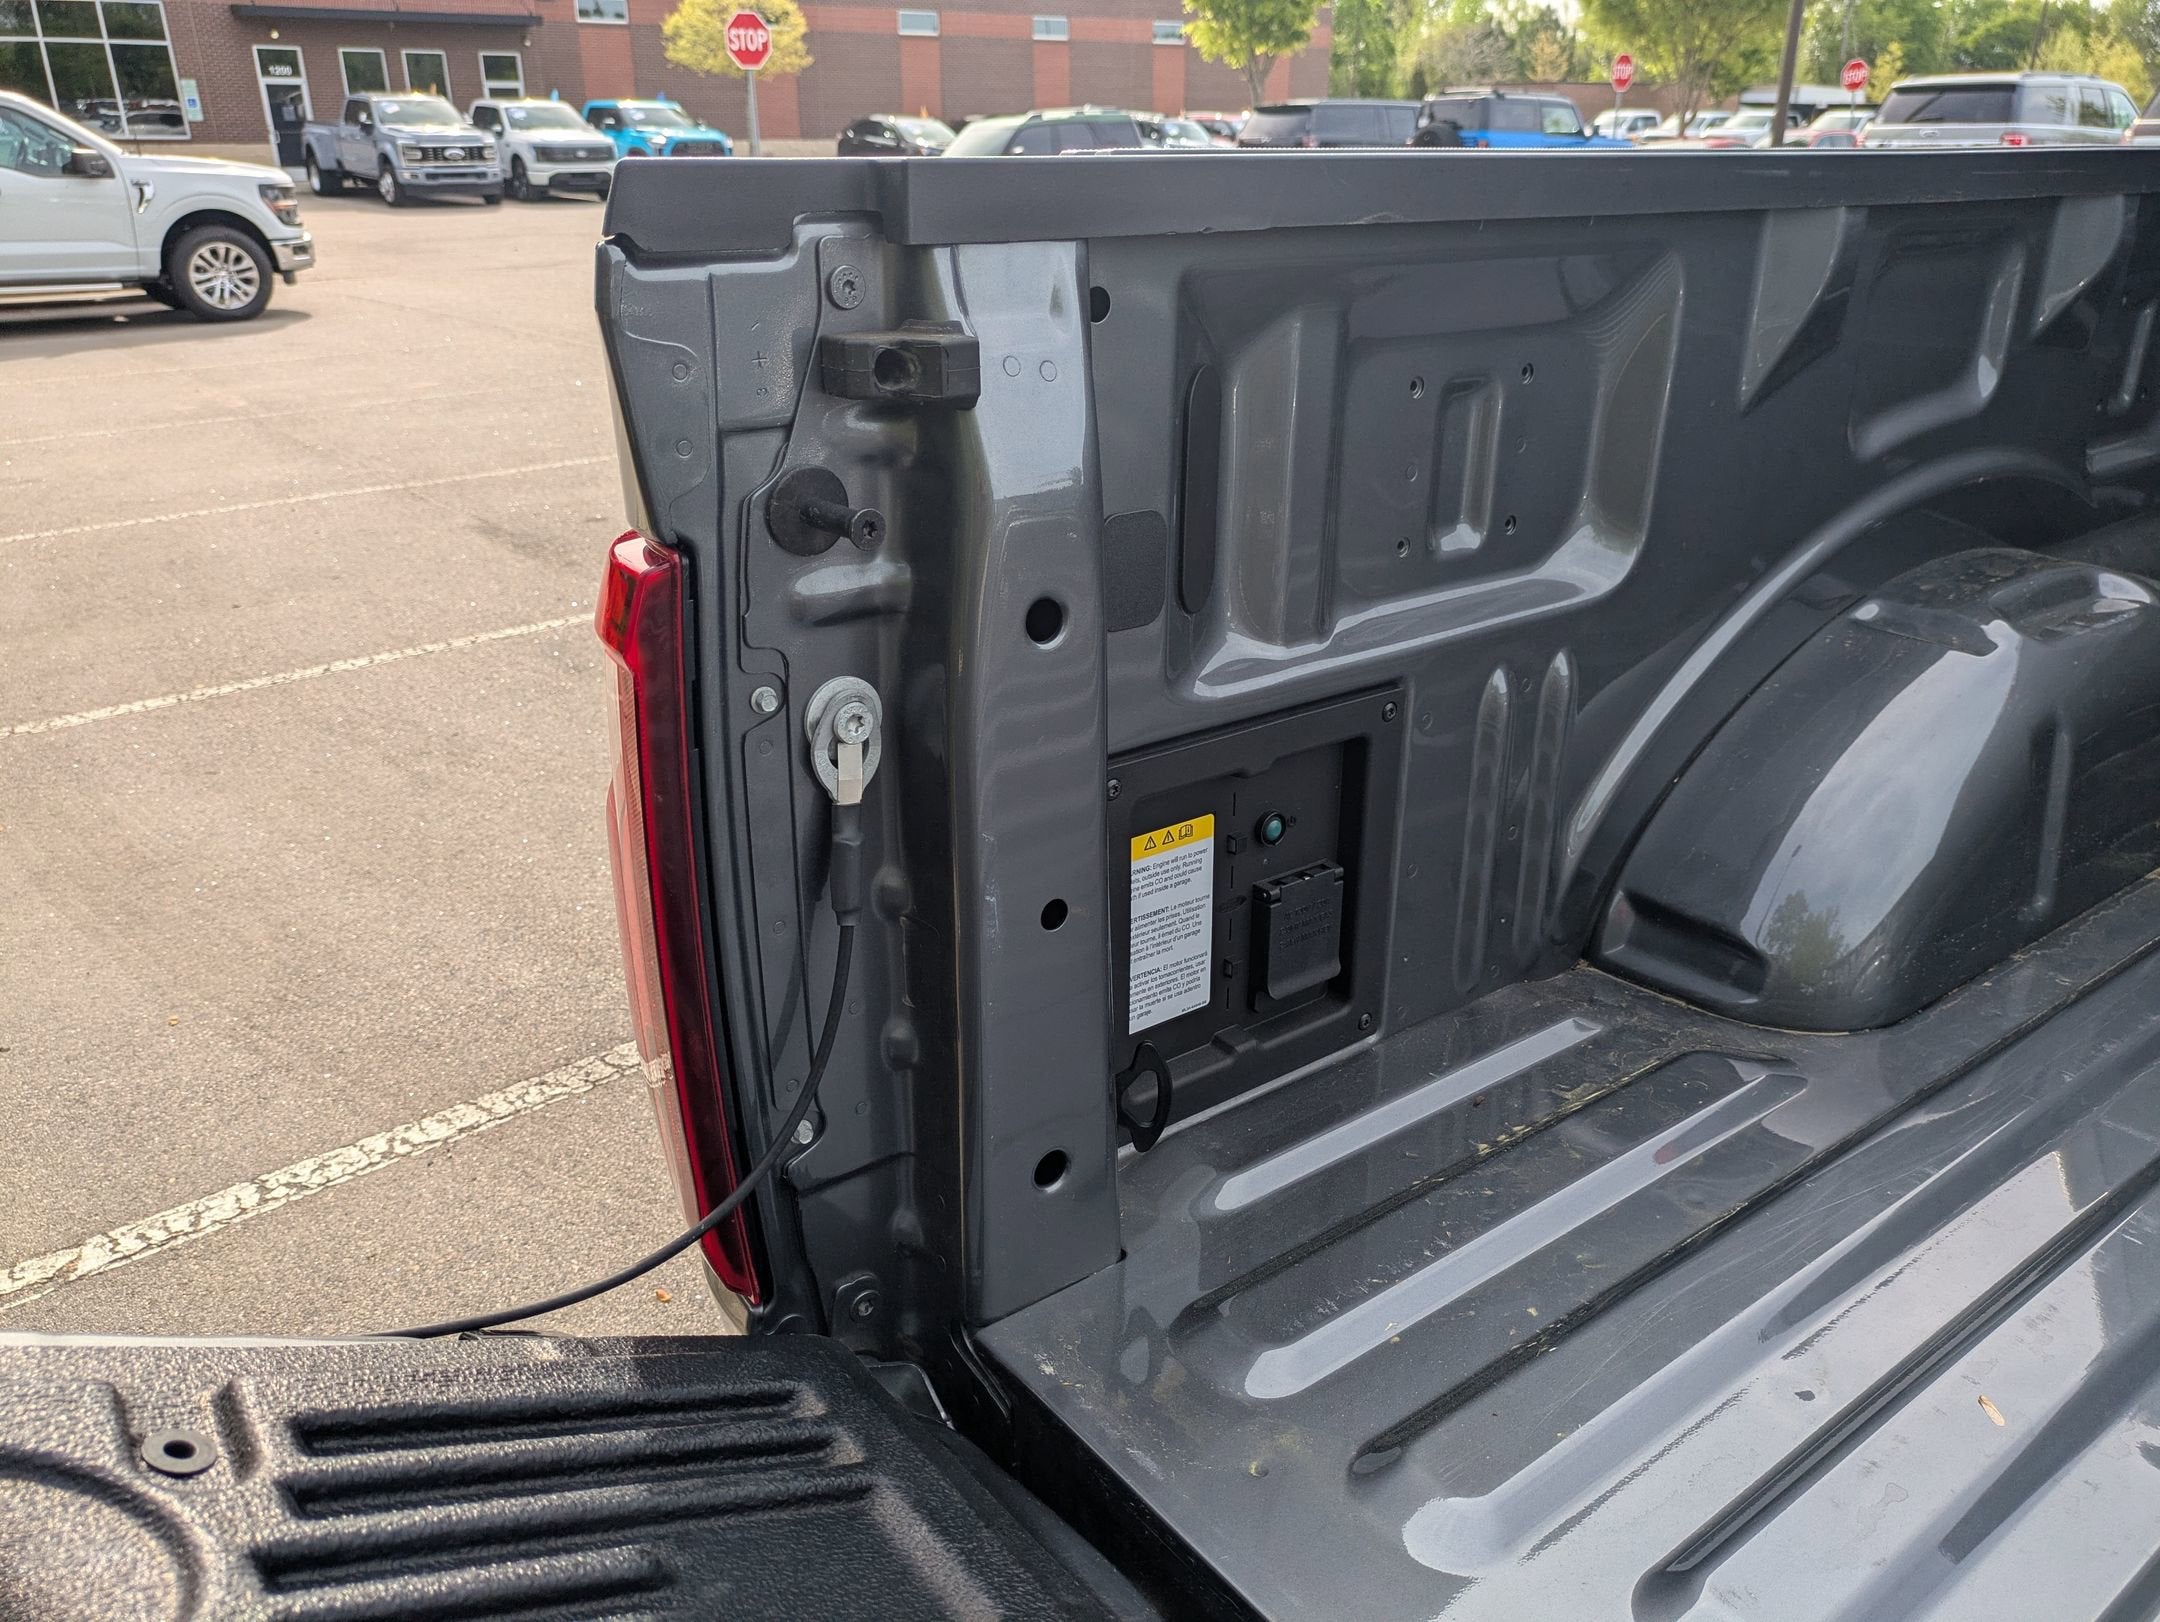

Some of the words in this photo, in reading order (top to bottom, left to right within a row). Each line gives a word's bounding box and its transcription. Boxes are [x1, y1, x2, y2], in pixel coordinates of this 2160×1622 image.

[729, 28, 768, 52] STOP
[1613, 64, 1632, 80] STOP
[1843, 69, 1868, 85] STOP
[1152, 860, 1169, 870] Engine
[1193, 848, 1207, 857] power
[1142, 871, 1159, 881] outside
[1182, 858, 1202, 868] Running
[1174, 870, 1187, 879] could
[1188, 866, 1201, 874] cause
[1142, 889, 1153, 897] used
[1154, 885, 1168, 893] inside
[1177, 899, 1194, 908] moteur
[1195, 894, 1209, 903] tourne
[1134, 919, 1156, 931] alimenter
[1182, 903, 1206, 915] Utilisation
[1178, 914, 1194, 924] Quand
[1184, 929, 1200, 940] garage
[1169, 960, 1182, 968] motor
[1186, 969, 1198, 977] motor
[1134, 979, 1149, 989] activar
[1172, 982, 1180, 990] CO
[1184, 984, 1200, 994] adentro
